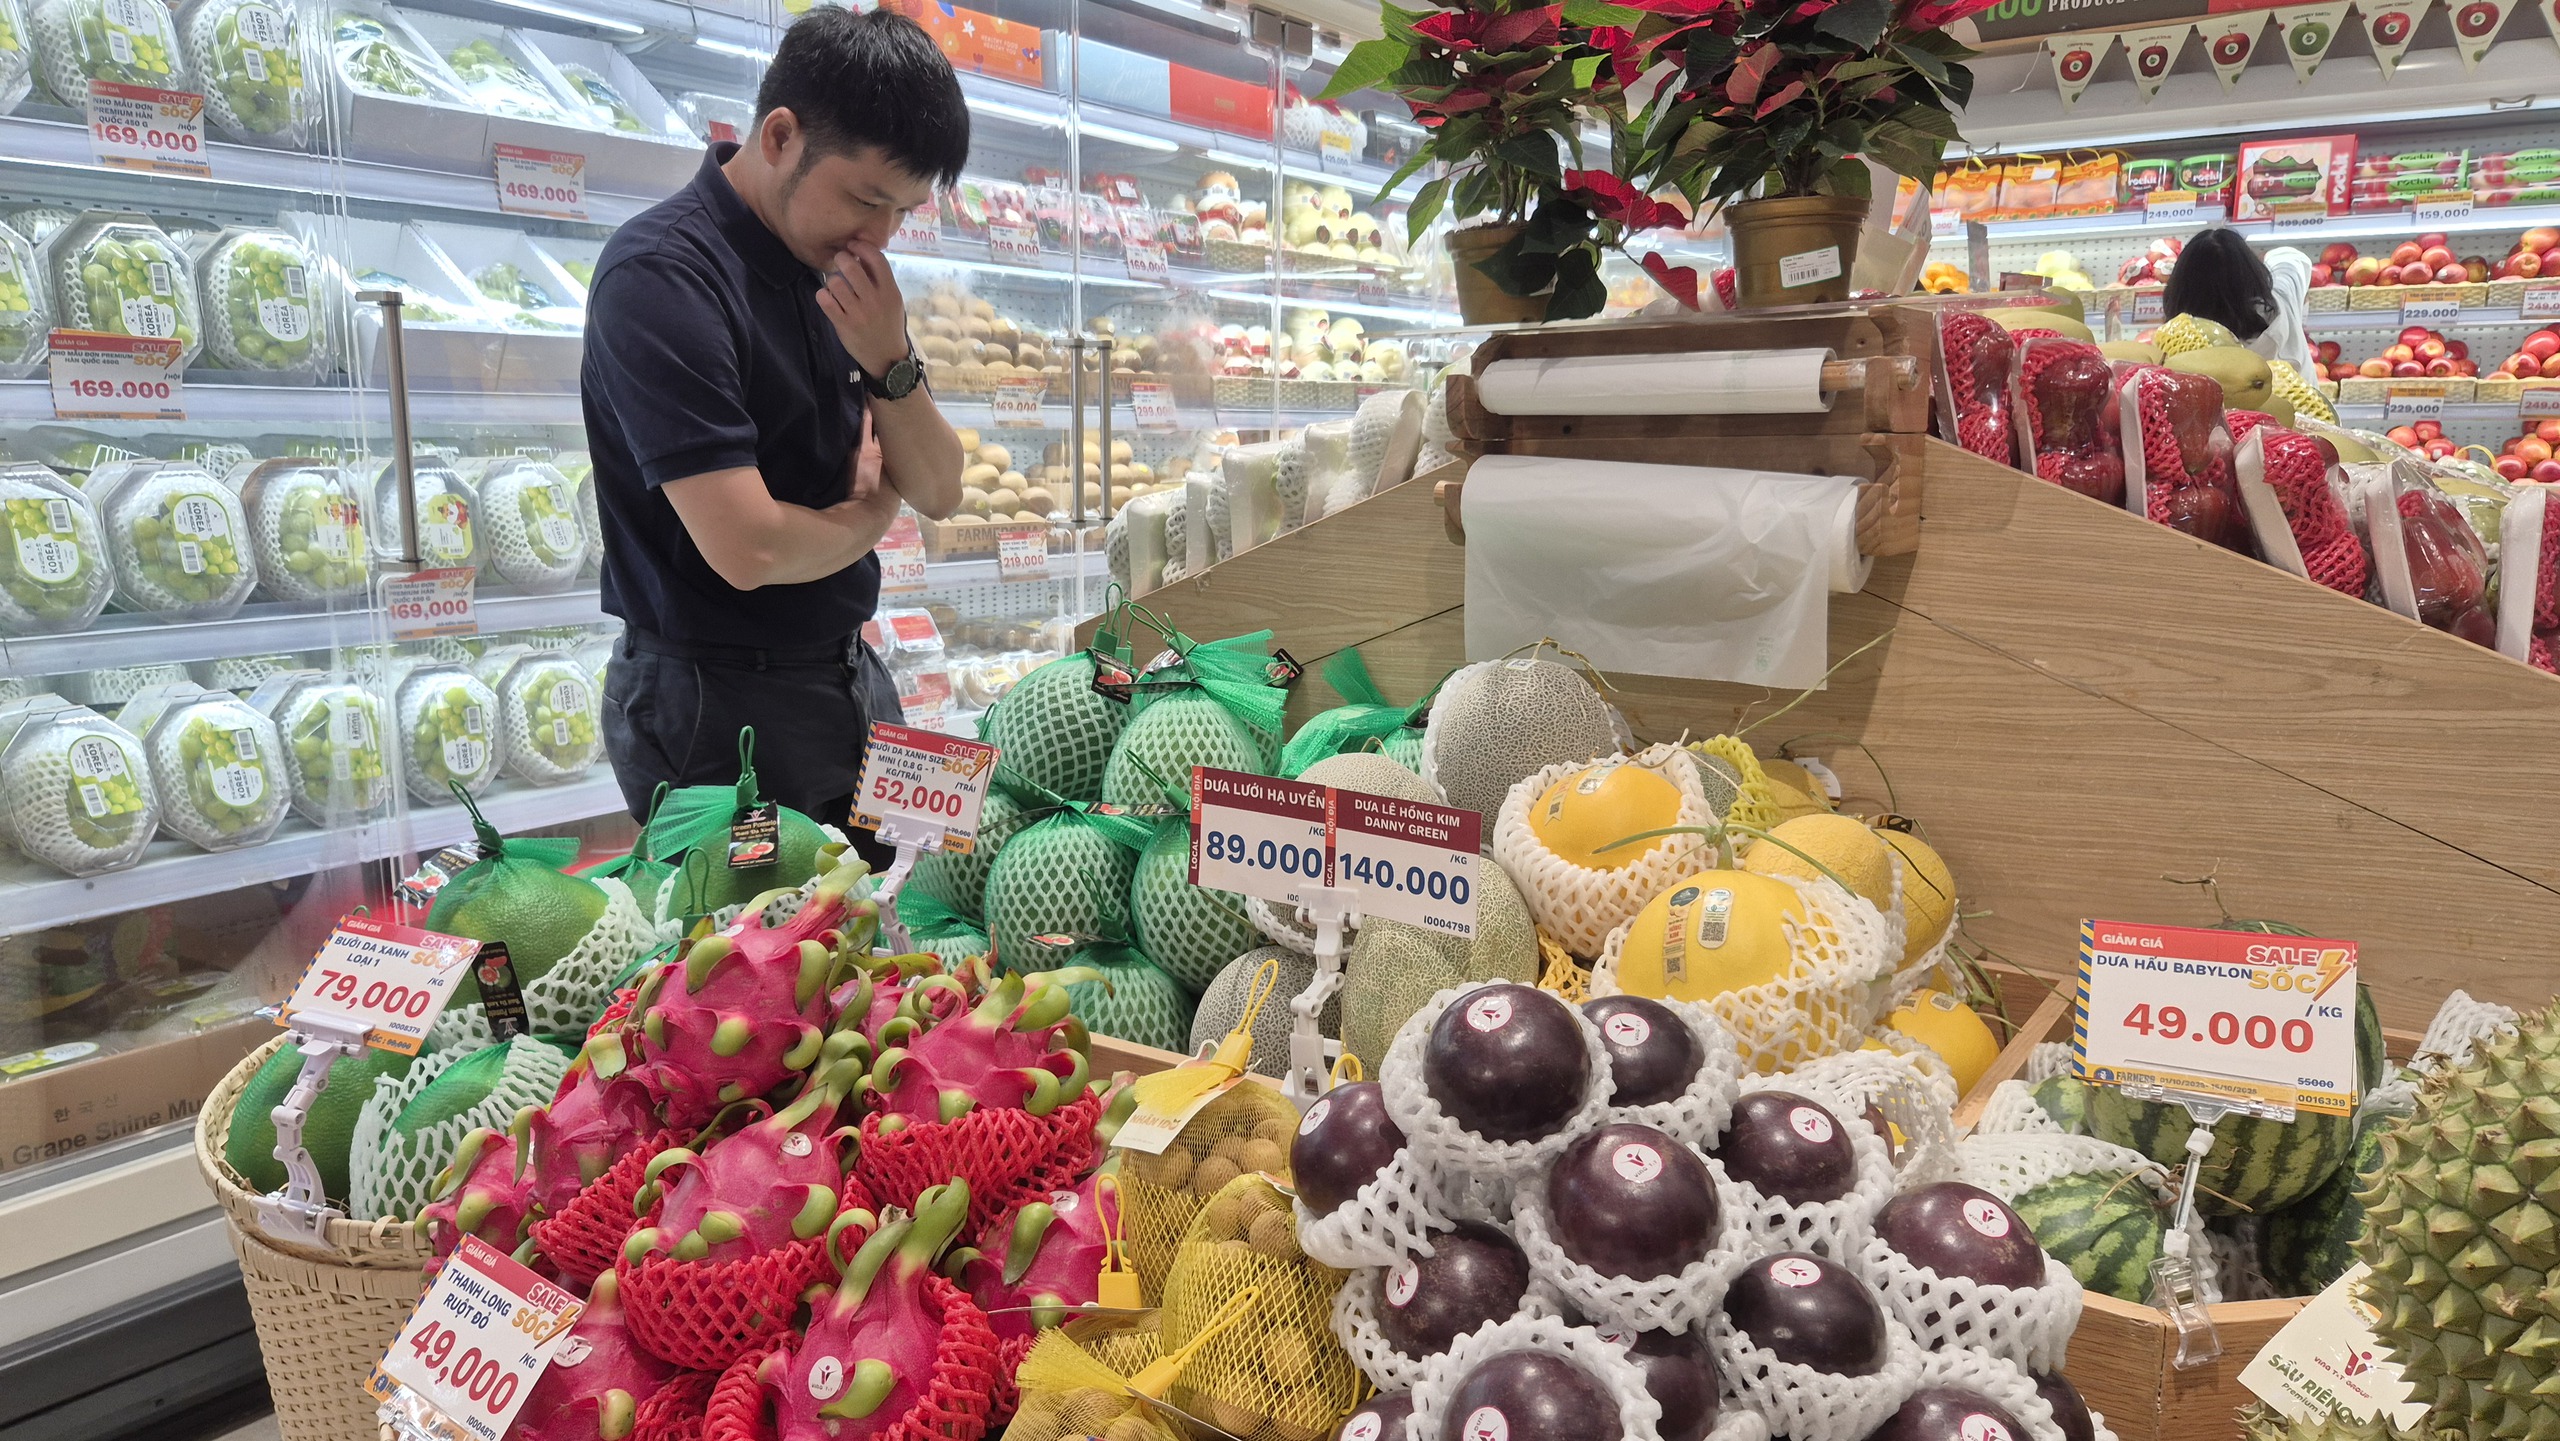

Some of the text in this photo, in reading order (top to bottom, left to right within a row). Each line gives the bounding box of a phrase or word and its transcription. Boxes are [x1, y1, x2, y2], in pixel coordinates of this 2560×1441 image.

[254, 11, 268, 43] KOREA
[93, 96, 153, 111] NHO MẪU ĐƠN
[160, 93, 191, 106] SALE
[93, 105, 153, 120] PREMIUM HÀN
[160, 103, 190, 119] SỐC
[98, 114, 123, 126] QUỐC
[124, 119, 140, 127] 450
[92, 122, 198, 153] 169,000
[550, 154, 574, 164] SALE
[2400, 153, 2434, 161] rockit
[2515, 152, 2552, 162] rockit
[2128, 175, 2157, 186] rockit
[2193, 171, 2220, 182] rockit
[2331, 153, 2349, 203] rockit
[2397, 177, 2432, 186] rockit
[506, 182, 577, 203] 469.000
[2519, 190, 2557, 200] rockit
[2148, 208, 2194, 219] 249,000
[2278, 217, 2324, 227] 499,000
[2419, 208, 2469, 220] 159,000
[992, 239, 1039, 257] 269,000
[1130, 259, 1167, 273] 169,000
[144, 304, 156, 336] KOREA
[283, 305, 292, 335] KOREA
[2405, 308, 2458, 319] 229.000
[67, 349, 83, 357] MẪU
[133, 343, 167, 354] SALE
[81, 357, 100, 365] QUỐC
[133, 354, 167, 367] SỐC
[70, 379, 170, 399] 169.000
[2390, 404, 2439, 414] 229,000
[192, 502, 205, 533] KOREA
[48, 542, 58, 574] KOREA
[1004, 555, 1044, 568] 219,000
[440, 571, 464, 579] SALE
[390, 599, 468, 621] 169,000
[562, 685, 573, 711] KOREA
[879, 729, 908, 741] GIẢM GIÁ
[87, 743, 103, 775] KOREA
[872, 742, 946, 765] BƯỞI DA XANH SIZE
[944, 743, 976, 760] SALE
[878, 755, 896, 765] MINI
[903, 760, 915, 769] 0.8
[917, 763, 923, 771] G
[942, 758, 973, 777] SỐC
[886, 767, 922, 783] KG/TRÁI)
[234, 769, 246, 799] KOREA
[955, 782, 976, 793] /TRÁI
[872, 776, 963, 817] 52,000
[1203, 778, 1326, 810] DƯA LƯỚI HẠ UYỂN
[1355, 799, 1460, 828] DƯA LÊ HỒNG KIM
[753, 820, 777, 828] Pomelo
[1308, 825, 1325, 838] /KG
[1364, 816, 1449, 841] DANNY GREEN
[1191, 838, 1199, 871] LOCAL
[1206, 830, 1323, 879] 89.000
[1450, 854, 1468, 866] /KG
[1340, 852, 1470, 905] 140.000
[346, 919, 381, 934] GIẢM GIÁ
[334, 935, 411, 959] BƯỞI DA XANH
[2101, 932, 2164, 949] GIẢM GIÁ
[347, 953, 381, 968] LOẠI 1
[2247, 945, 2317, 966] SALE
[2096, 954, 2252, 980] DƯA HẤU BABYLON
[427, 977, 444, 987] /KG
[2249, 965, 2316, 993] SỐC
[313, 969, 431, 1019] 79,000
[2304, 1004, 2343, 1019] / KG
[2122, 1002, 2314, 1054] 49.000
[2116, 1072, 2156, 1084] FARMERS
[2297, 1077, 2334, 1089] 55000
[2296, 1095, 2346, 1107] 0016339
[13, 1111, 161, 1165] Grape Shine
[466, 1243, 498, 1269] GIẢM GIÁ
[447, 1268, 512, 1318] THANH LONG
[527, 1282, 567, 1316] SALE
[443, 1292, 491, 1330] RUỘT ĐỎ
[511, 1307, 550, 1341] SỐC
[410, 1319, 519, 1416] 49,000
[519, 1352, 537, 1370] /KG
[2267, 1353, 2353, 1423] SẦU RIÊNG
[2345, 1379, 2371, 1399] GROUP
[2281, 1382, 2319, 1412] Premium
